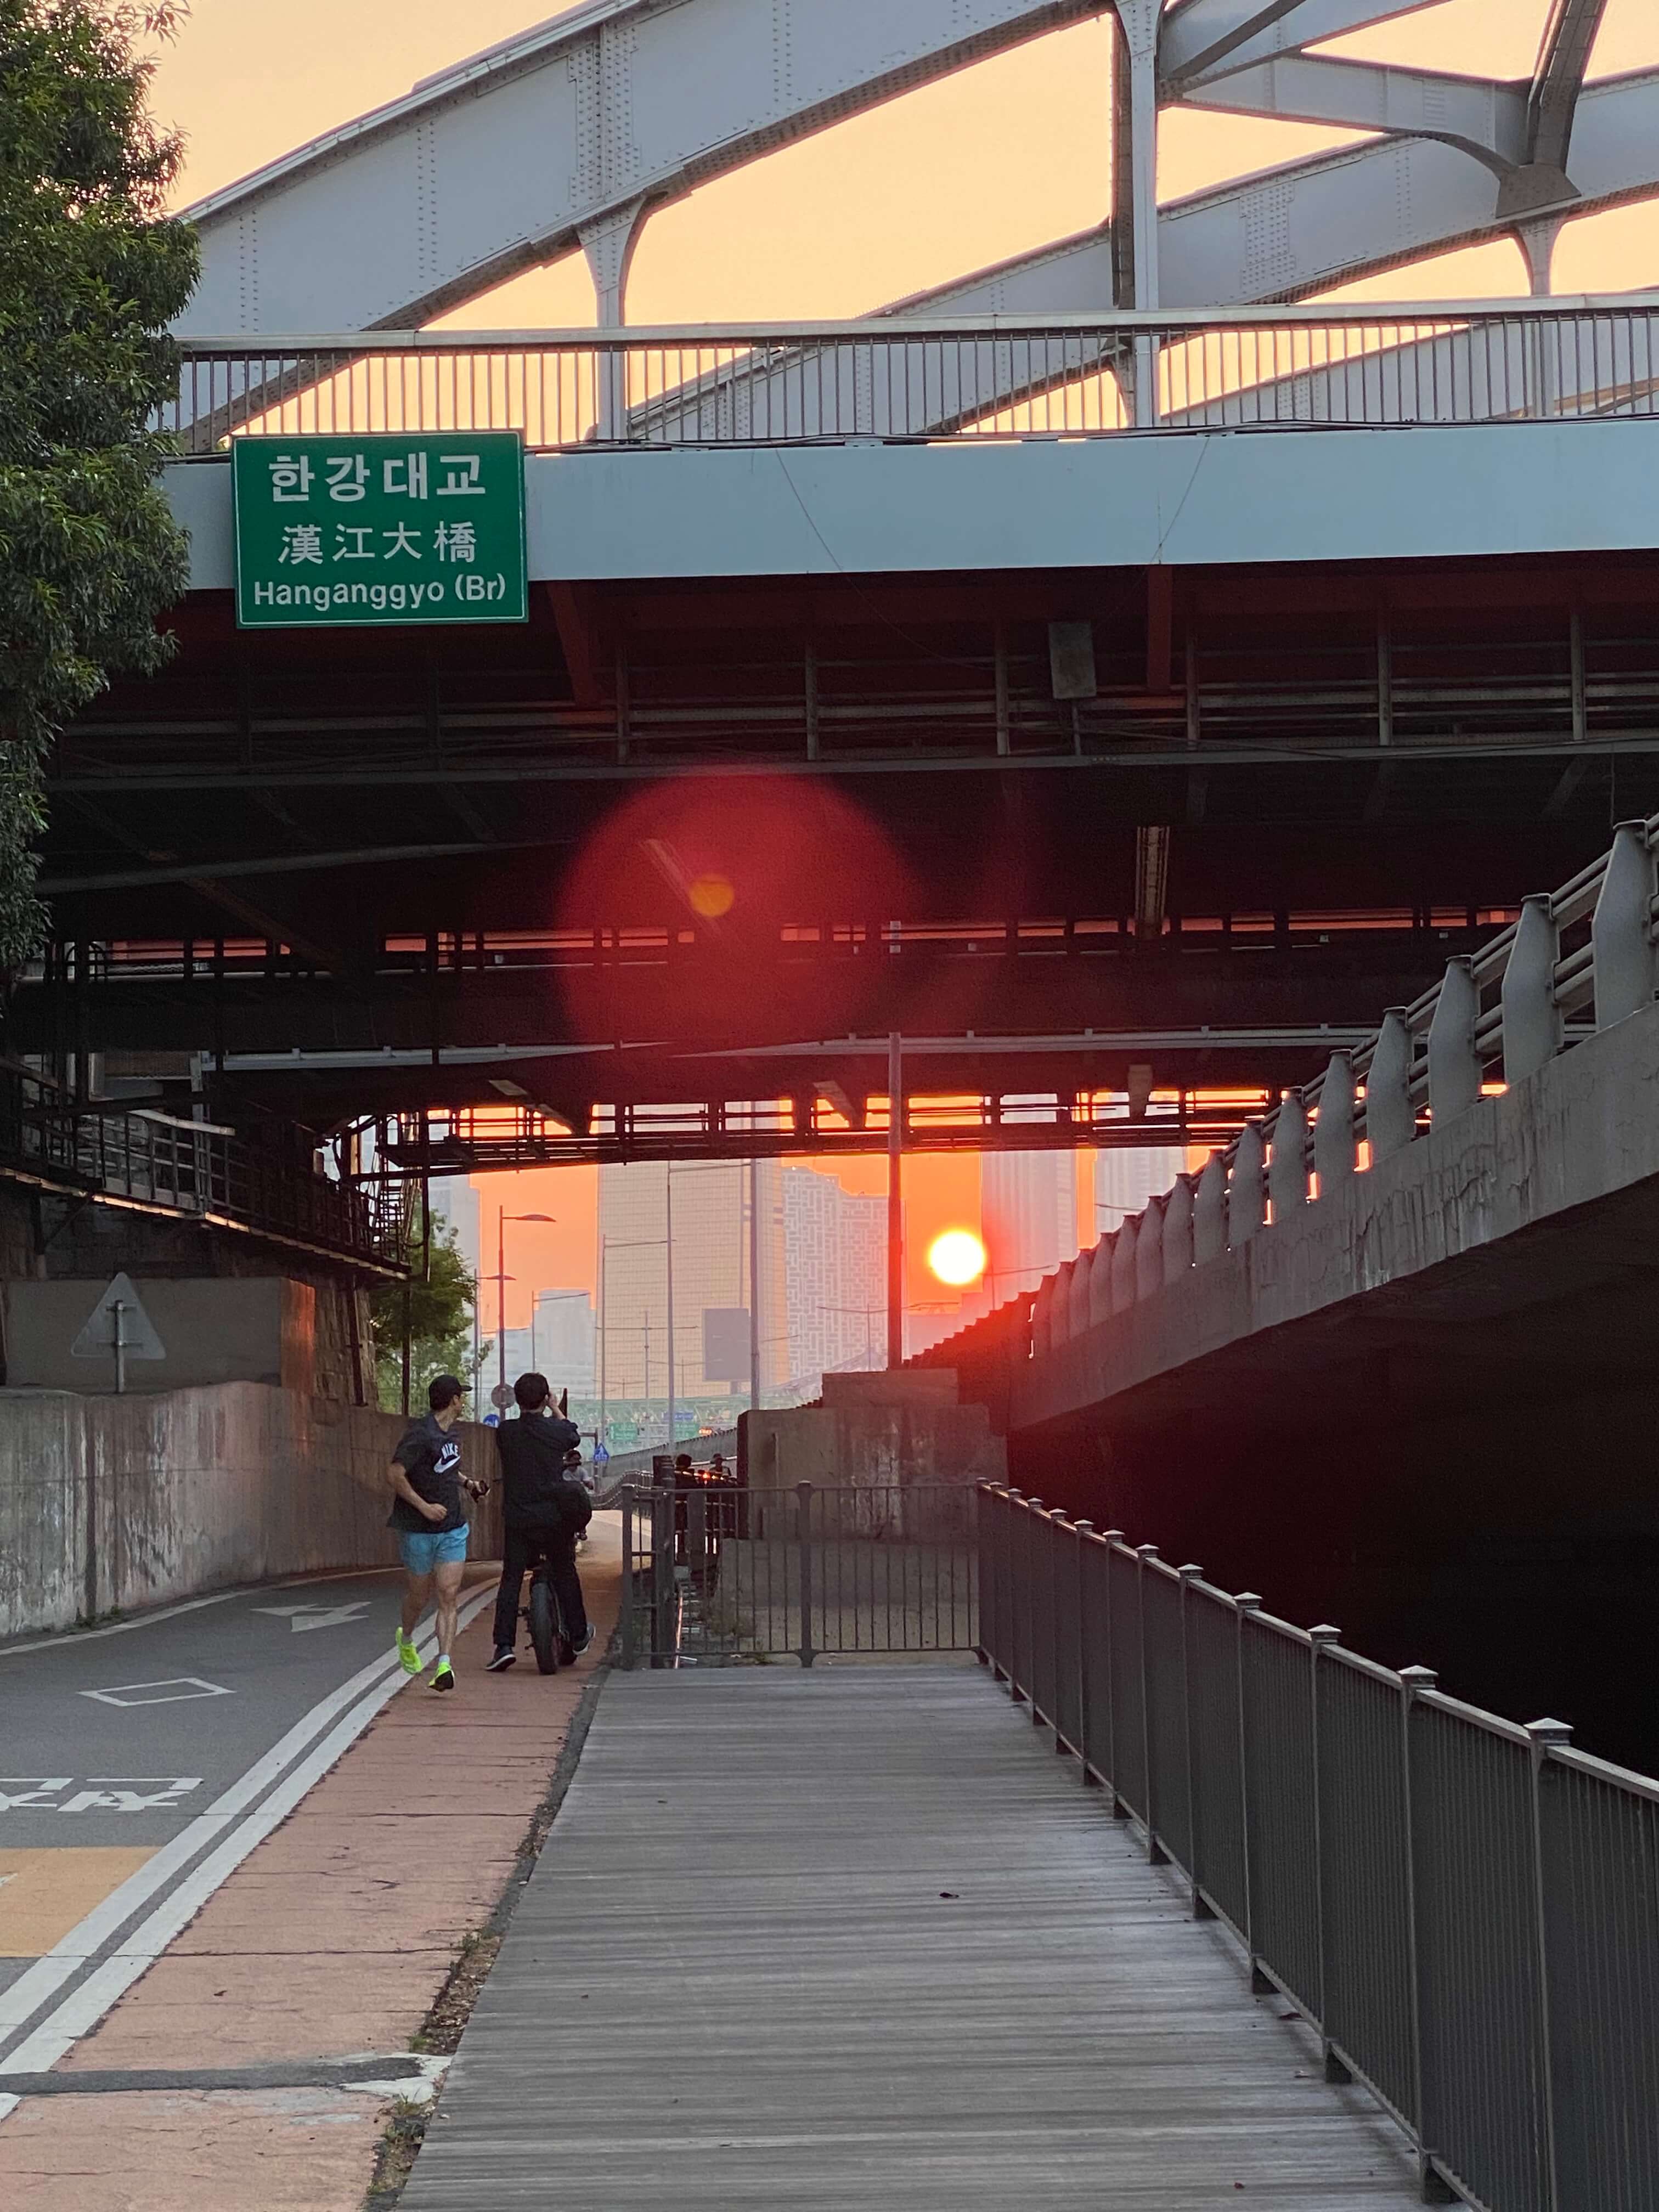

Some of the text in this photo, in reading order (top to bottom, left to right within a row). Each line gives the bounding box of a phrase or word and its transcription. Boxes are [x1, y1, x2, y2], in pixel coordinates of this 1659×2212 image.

[268, 452, 486, 502] 한강대교
[278, 521, 477, 565] 漢江大橋
[253, 572, 506, 612] Hanganggyo (Br)
[441, 1443, 459, 1459] NIKE
